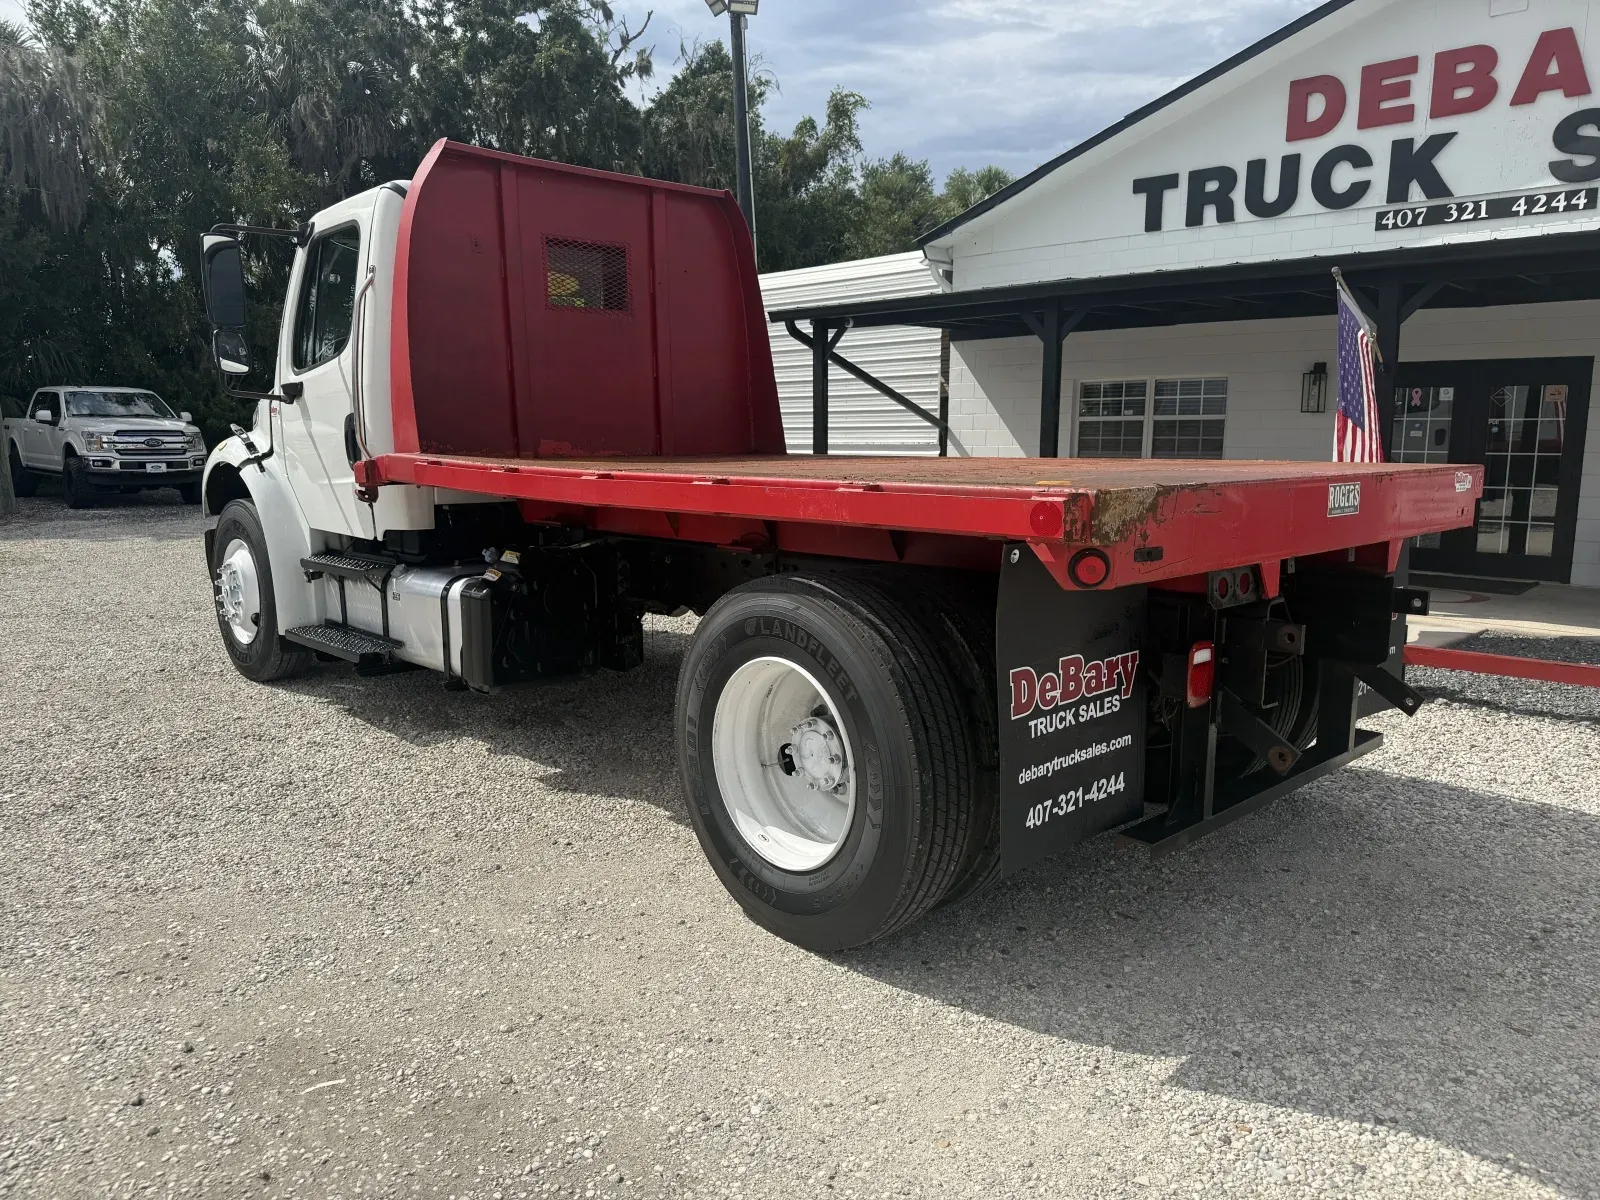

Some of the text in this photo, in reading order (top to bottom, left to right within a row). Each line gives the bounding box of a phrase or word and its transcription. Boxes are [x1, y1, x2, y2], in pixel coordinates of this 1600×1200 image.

[1285, 27, 1592, 142] DEBA
[1132, 131, 1459, 233] TRUCK
[1381, 189, 1588, 230] 407 321 4244
[1329, 484, 1360, 508] ROGERS
[1010, 650, 1140, 720] DeBary
[1028, 694, 1121, 739] TRUCK SALES
[1018, 734, 1132, 785] debarytrucksales.com
[1025, 771, 1126, 829] 407-321-4244
